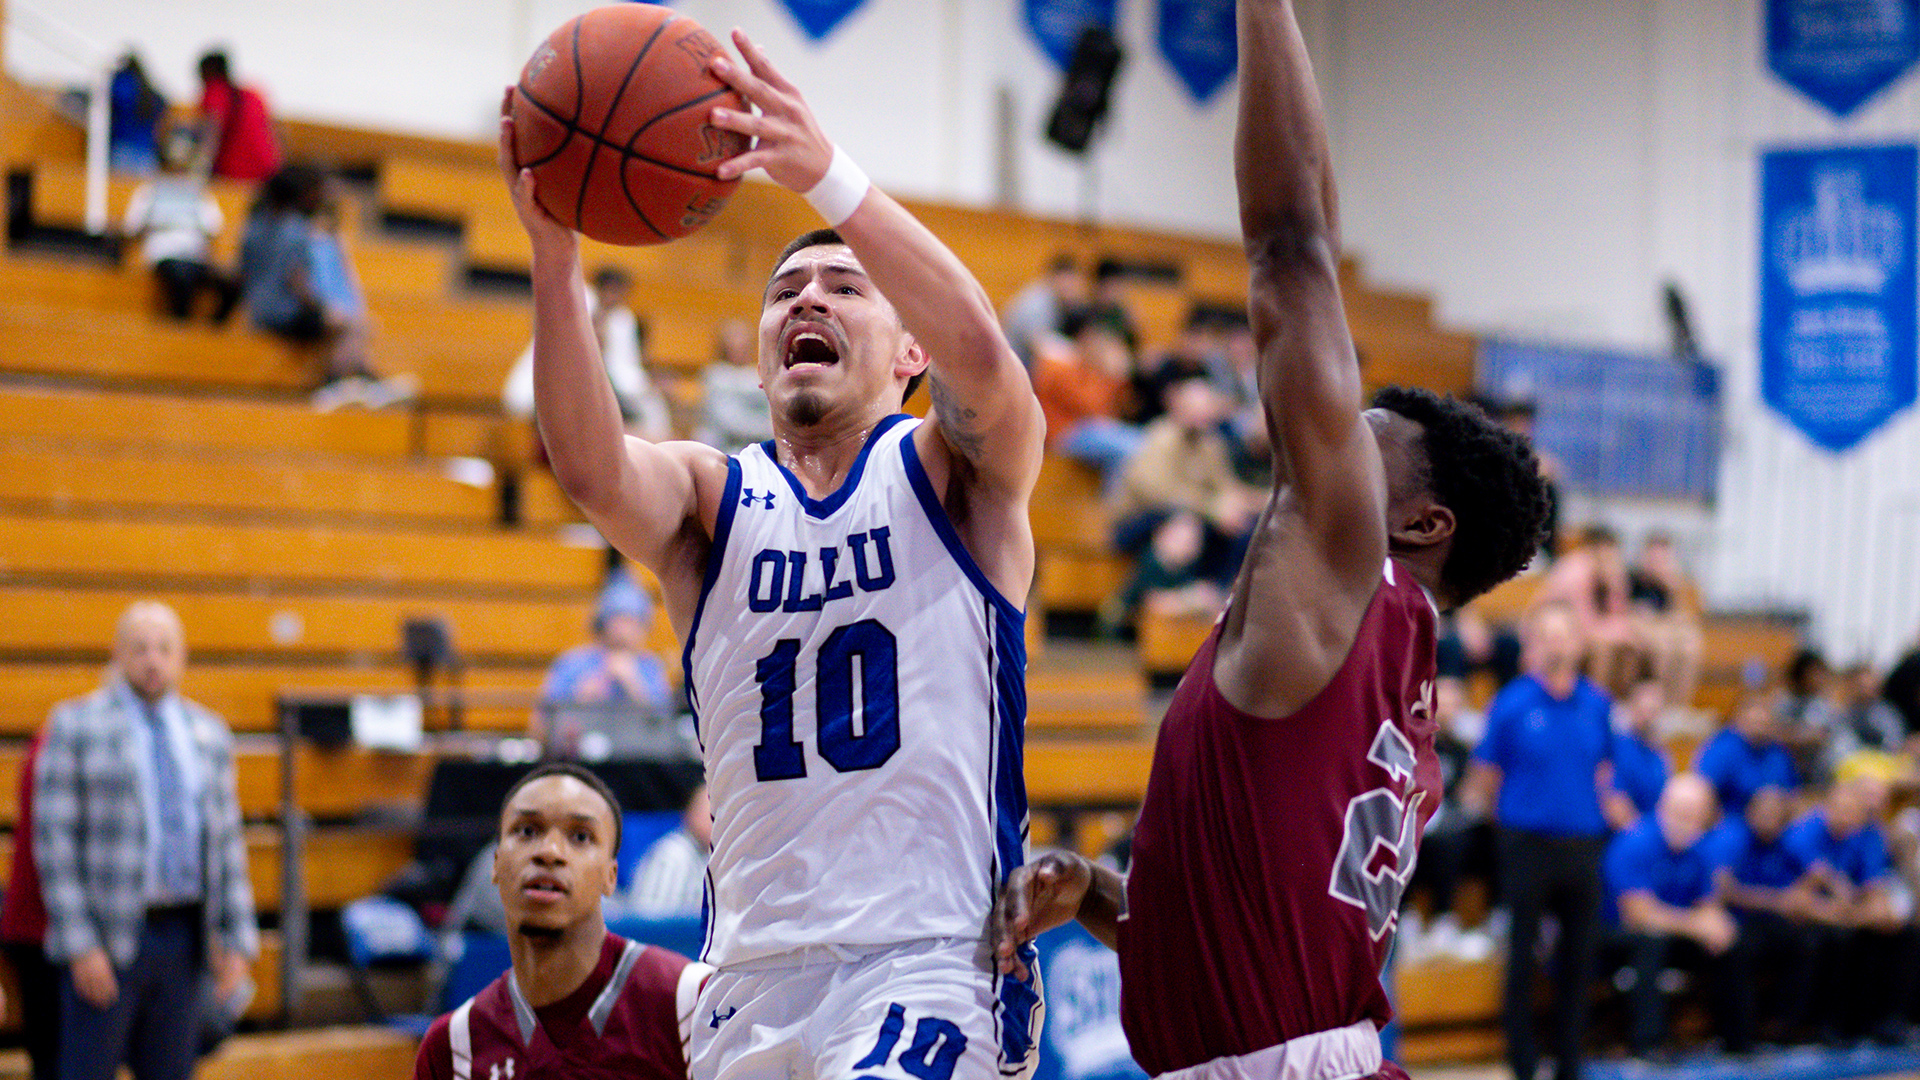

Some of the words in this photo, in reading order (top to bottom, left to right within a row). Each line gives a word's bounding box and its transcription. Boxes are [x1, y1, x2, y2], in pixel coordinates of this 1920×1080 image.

[748, 525, 896, 614] OLLU
[754, 618, 901, 782] 10
[851, 1001, 968, 1080] 10
